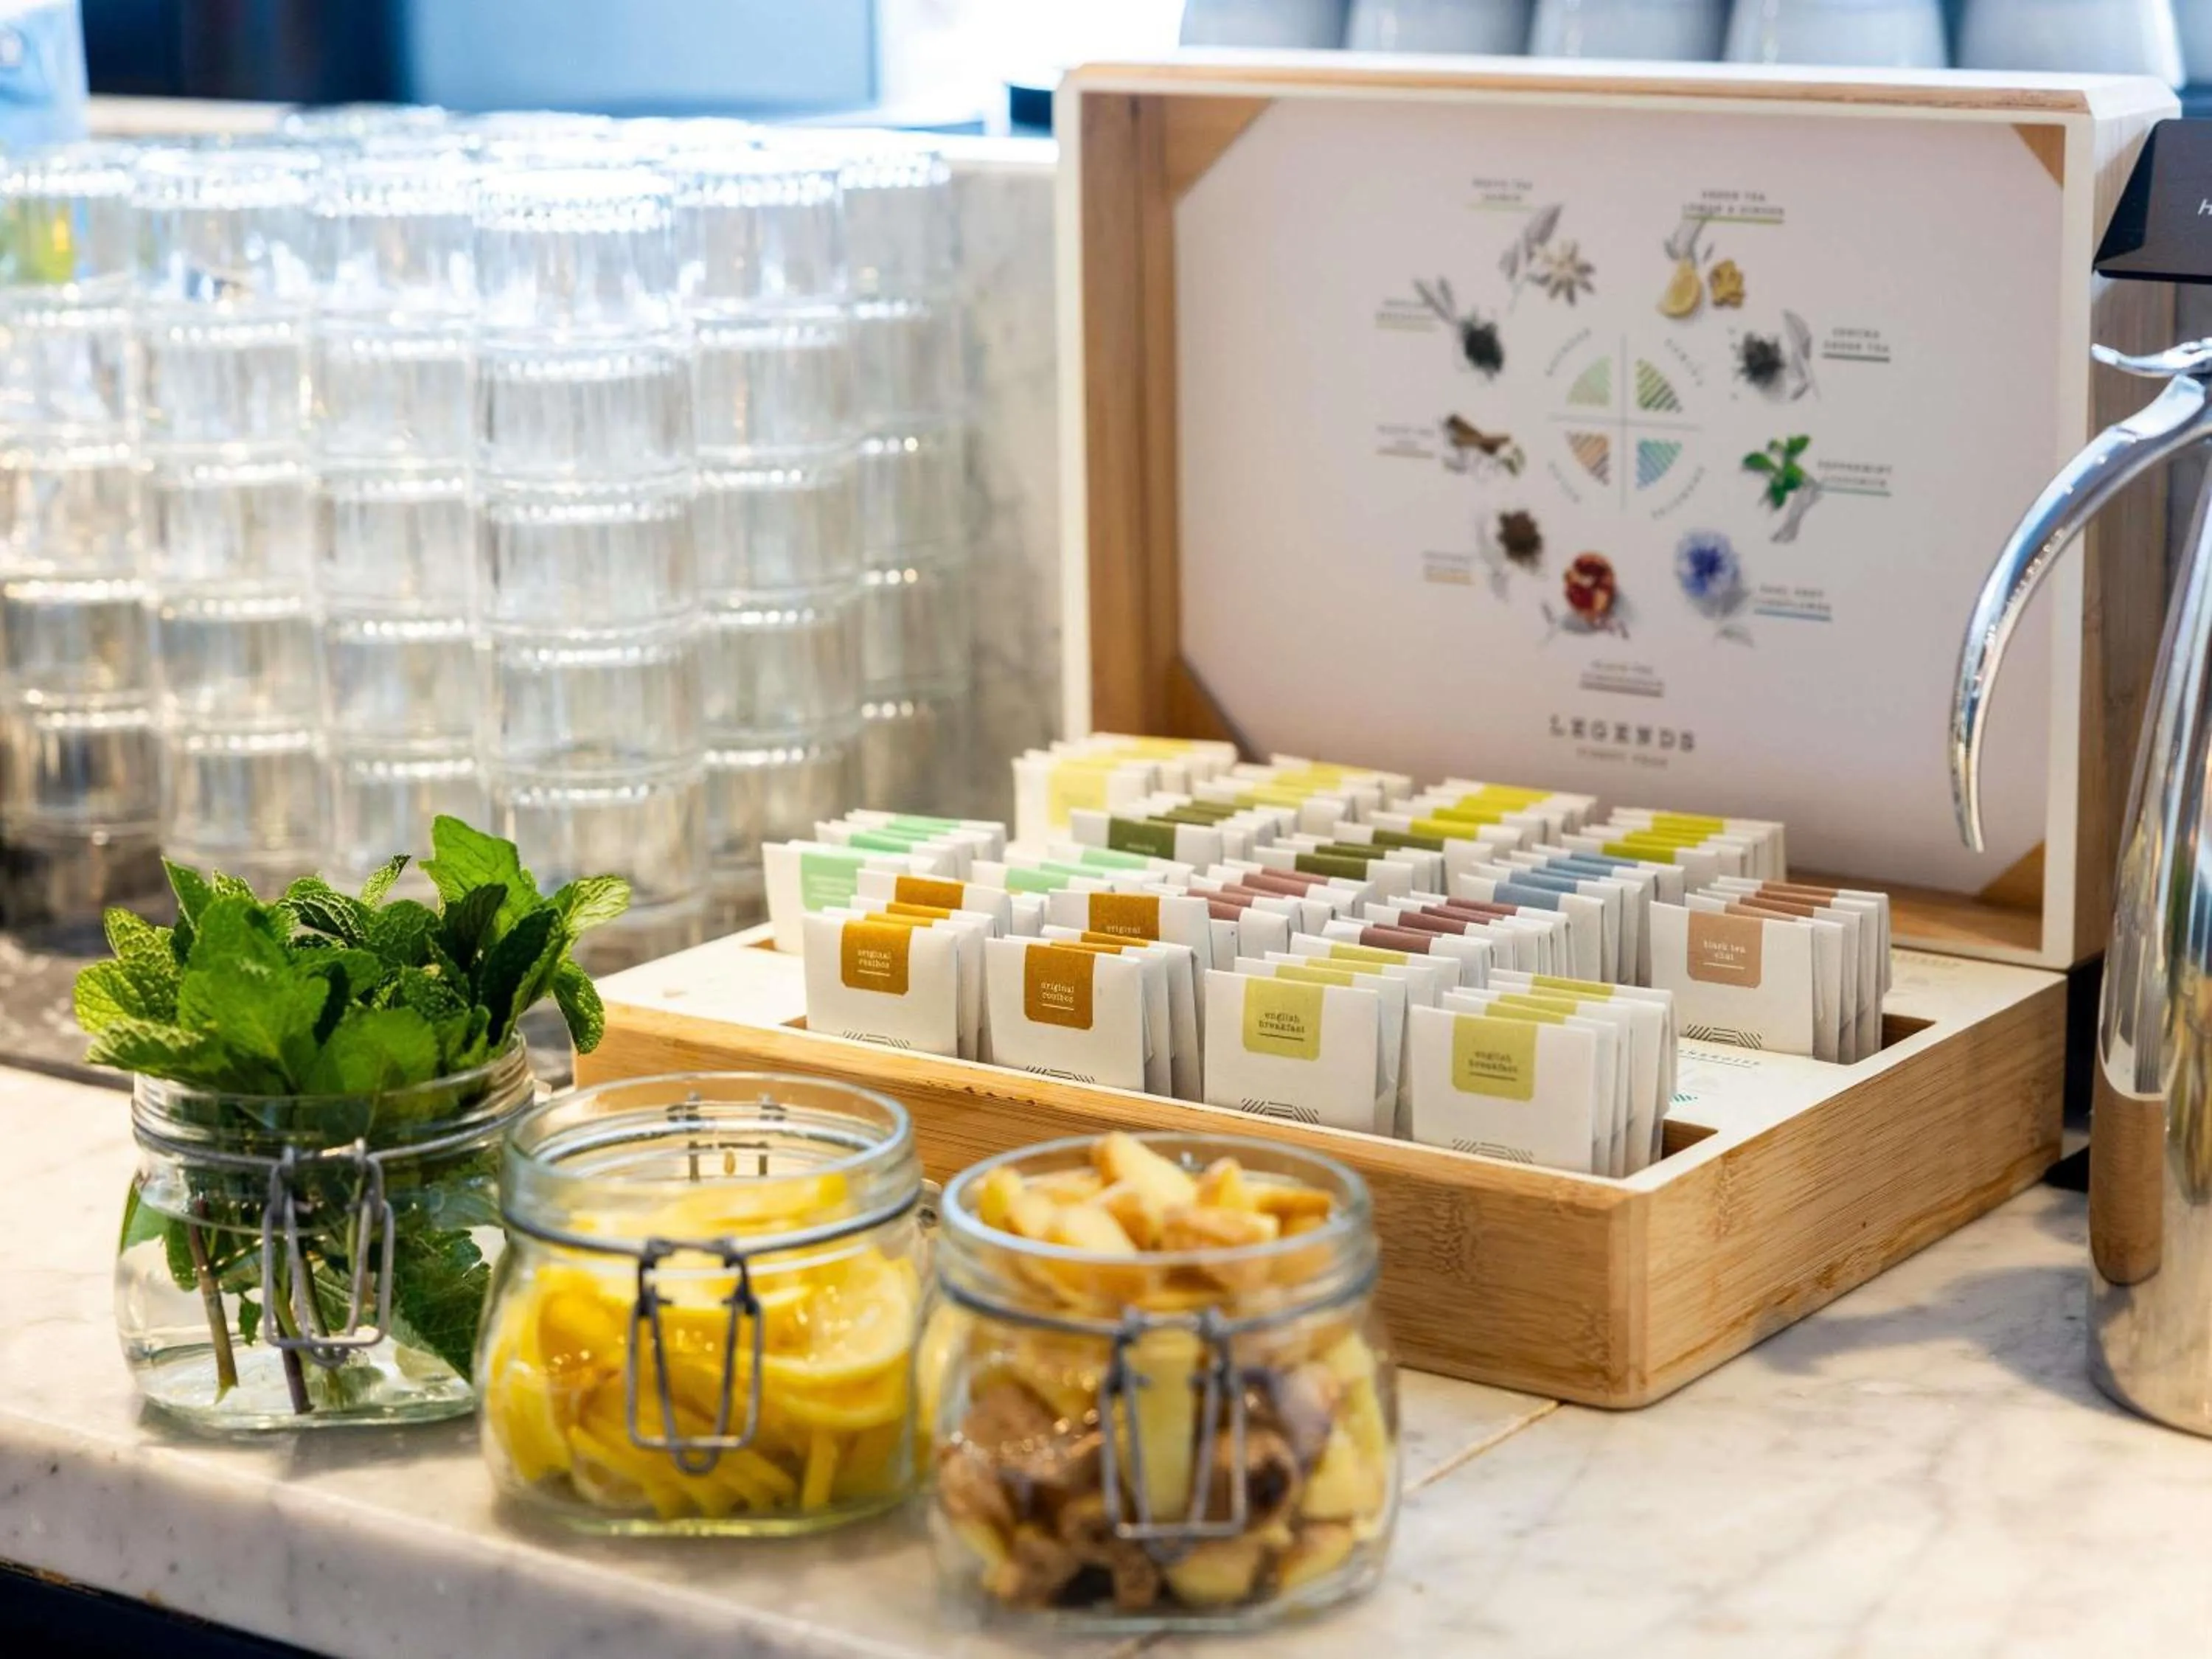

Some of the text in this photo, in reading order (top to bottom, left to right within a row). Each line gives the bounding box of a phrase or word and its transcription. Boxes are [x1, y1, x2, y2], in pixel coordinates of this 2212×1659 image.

[1549, 713, 1695, 754] LEGENDS
[1106, 924, 1141, 935] original
[857, 948, 892, 961] original
[1040, 981, 1074, 994] original
[1042, 992, 1074, 1004] rooibos
[1264, 1012, 1300, 1024] english
[1258, 1020, 1304, 1034] breakfast
[1475, 1050, 1512, 1063] english
[1468, 1057, 1517, 1074] breakfast
